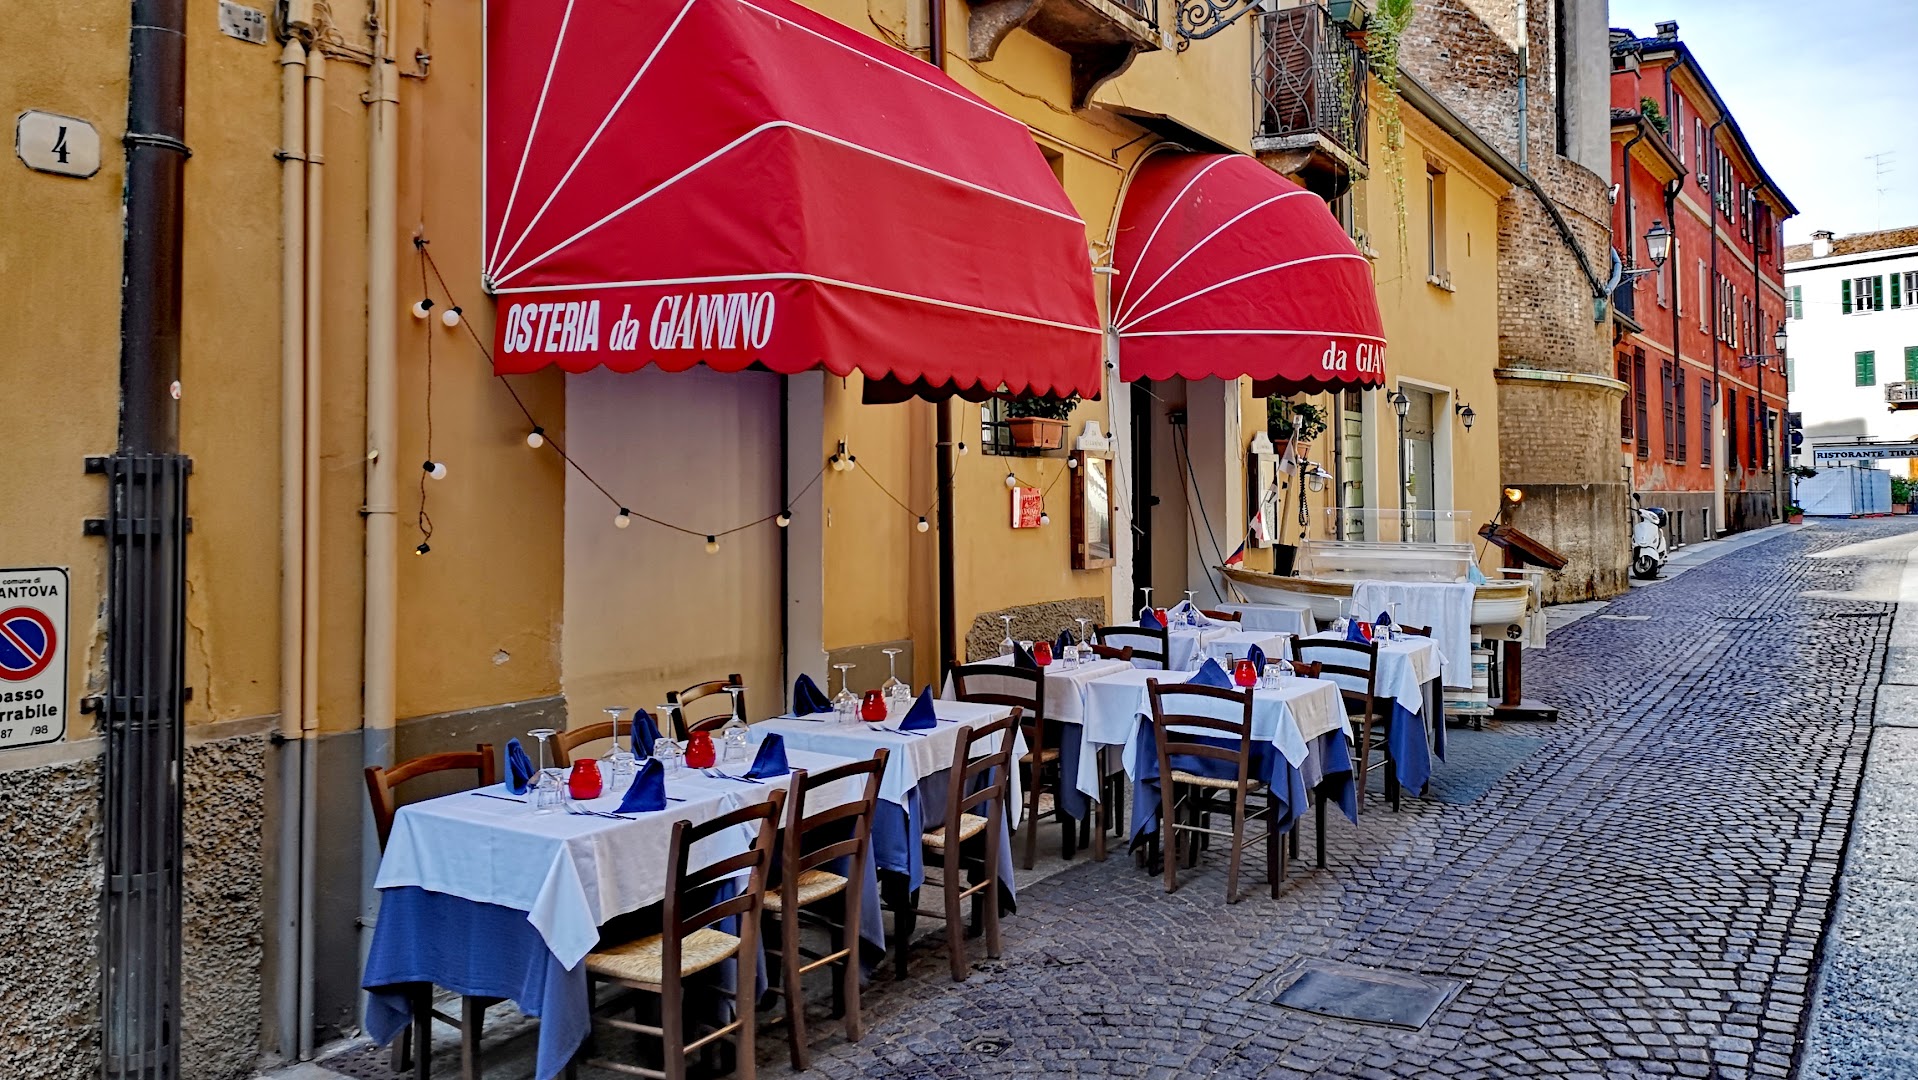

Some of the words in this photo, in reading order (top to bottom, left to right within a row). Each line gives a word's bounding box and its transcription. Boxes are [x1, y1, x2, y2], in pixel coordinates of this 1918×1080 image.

[51, 126, 71, 164] 4
[503, 300, 600, 353] OSTERIA
[609, 304, 640, 351] da
[649, 291, 775, 350] GIANNINO
[1322, 341, 1347, 370] da
[1817, 451, 1884, 459] RISTORANTE
[30, 724, 48, 736] /98
